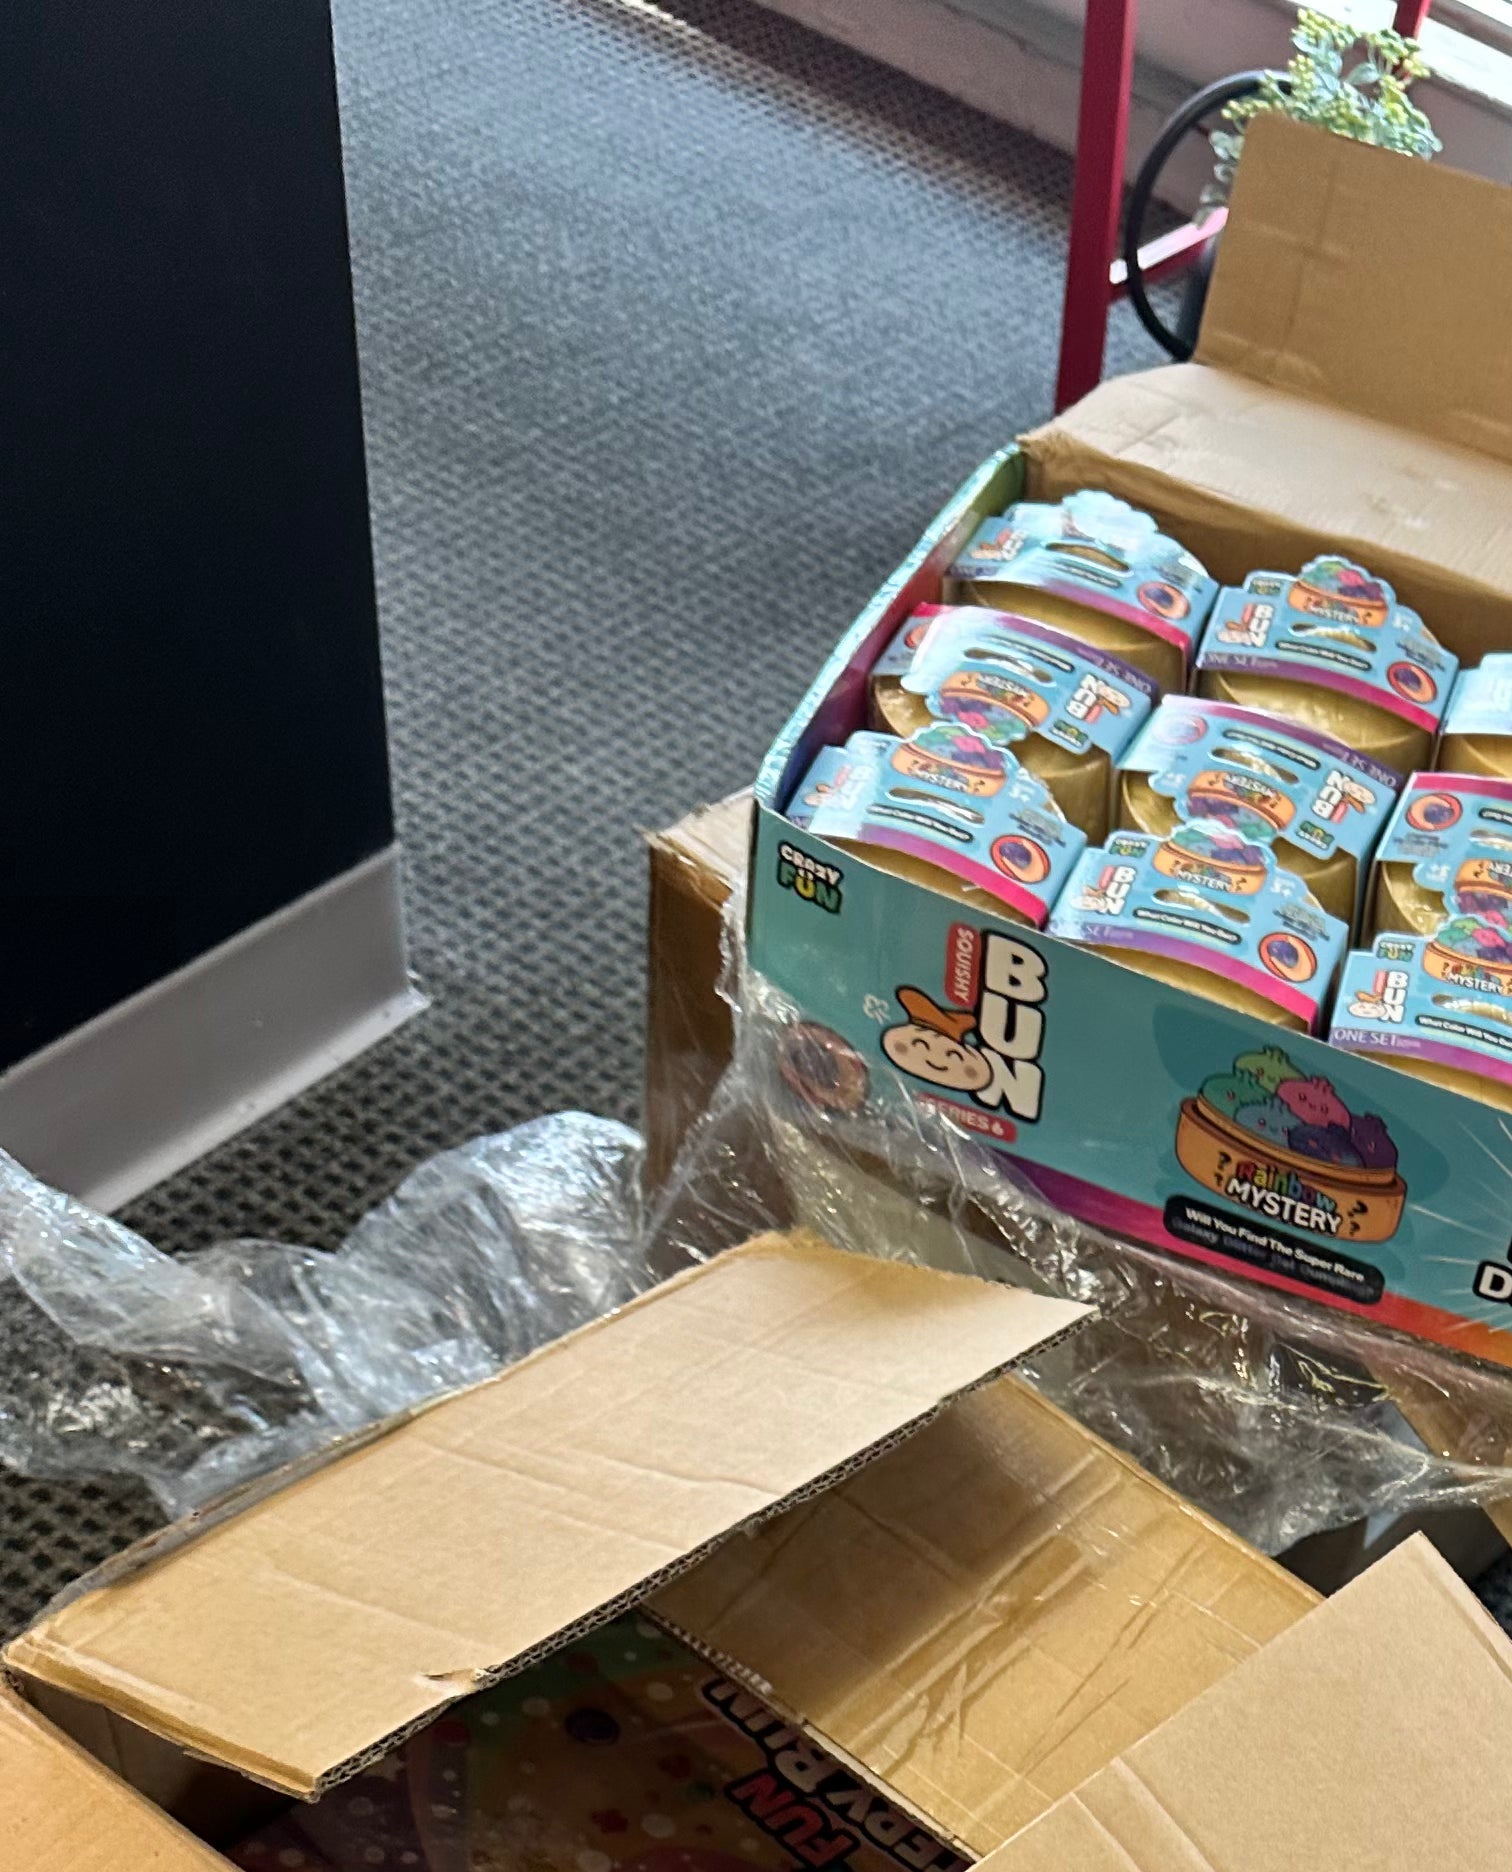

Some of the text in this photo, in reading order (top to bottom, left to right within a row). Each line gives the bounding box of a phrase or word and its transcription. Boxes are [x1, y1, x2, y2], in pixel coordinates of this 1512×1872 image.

[777, 865, 842, 913] FUN
[778, 843, 842, 886] CRAZY
[1176, 870, 1233, 892] MYSTERY
[1103, 866, 1137, 916] BUN
[954, 928, 975, 1002] SQUISHY
[1447, 972, 1504, 995] MYSTERY
[1380, 971, 1409, 1024] BUN
[973, 929, 1047, 1123] BUN
[1334, 1030, 1398, 1046] ONE SET
[1419, 1018, 1442, 1028] What
[1442, 1022, 1466, 1034] Color
[1466, 1027, 1483, 1038] Will
[1483, 1032, 1498, 1044] You
[1227, 1178, 1342, 1234] MYSTERY
[1237, 1161, 1337, 1211] Rainbow
[1185, 1206, 1212, 1227] Will
[1214, 1216, 1237, 1236] You
[1238, 1227, 1267, 1246] Find
[1270, 1238, 1293, 1256] The
[1294, 1248, 1331, 1272] Super
[1334, 1262, 1364, 1281] Rare
[725, 1769, 860, 1868] FUN
